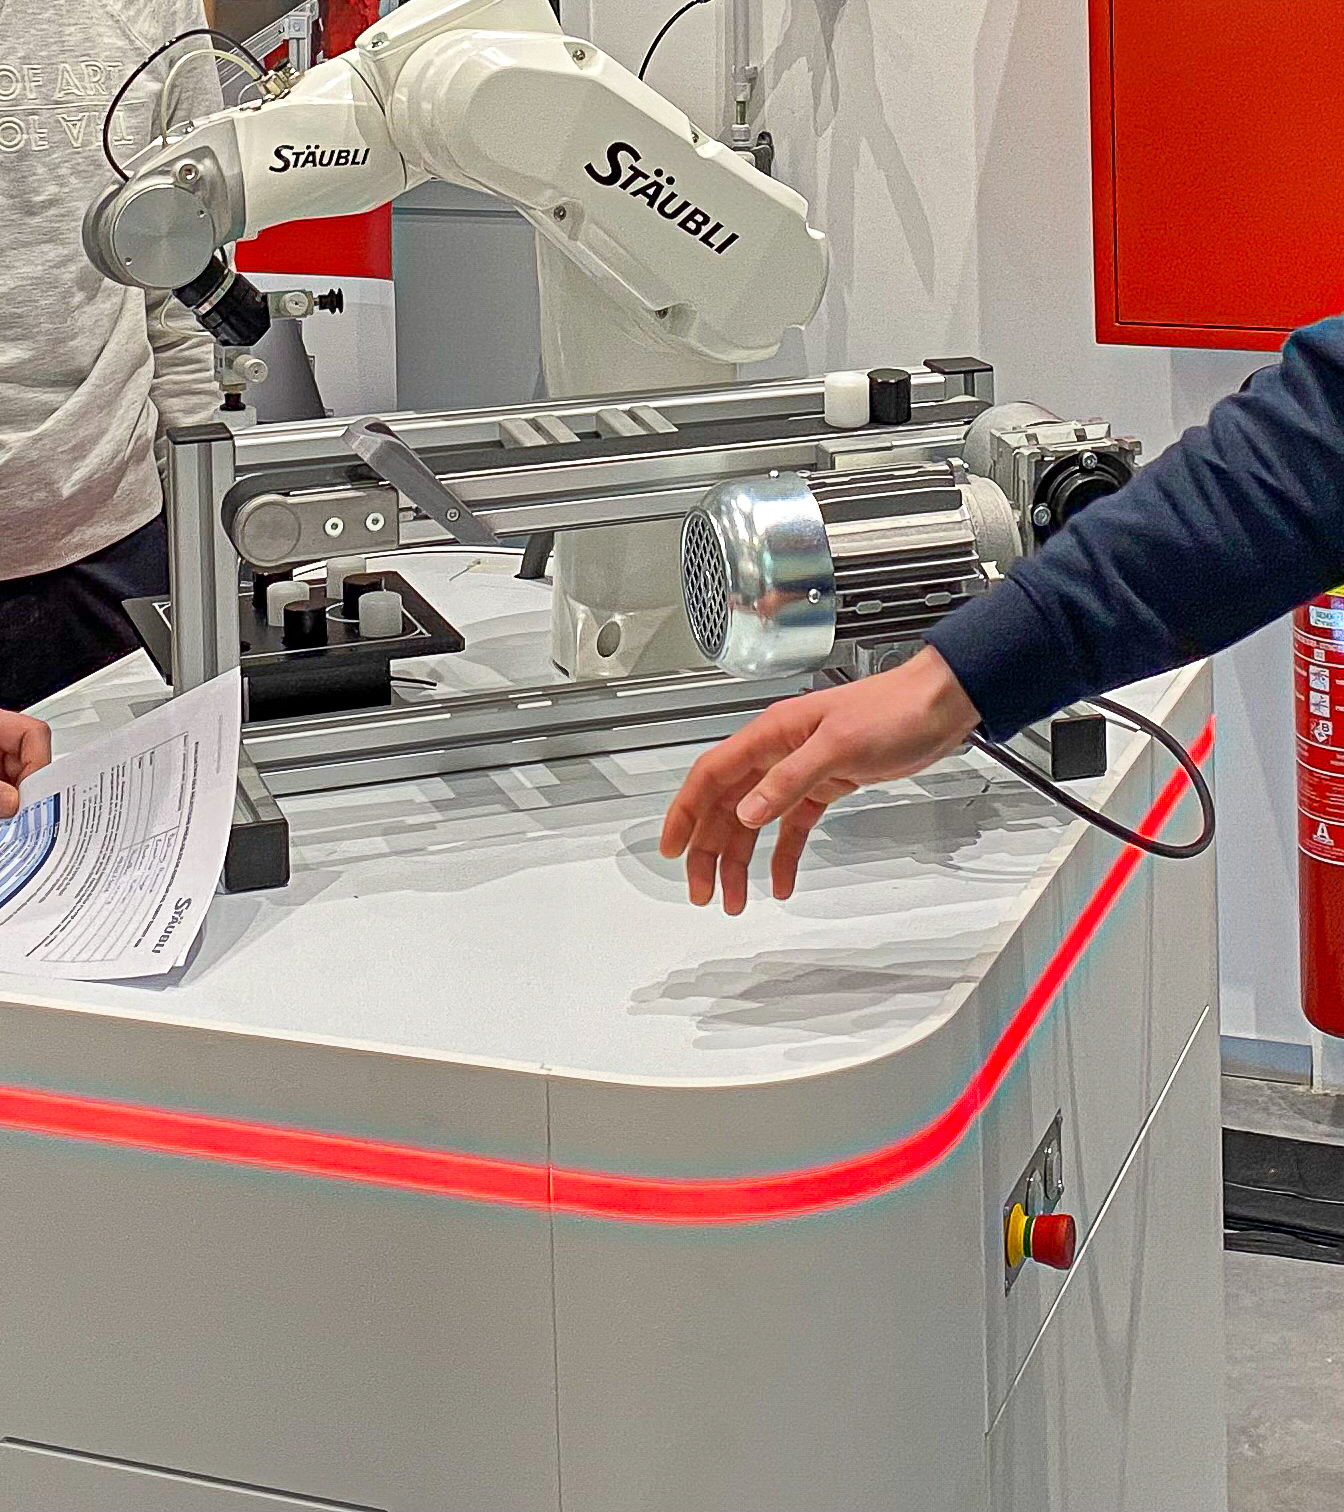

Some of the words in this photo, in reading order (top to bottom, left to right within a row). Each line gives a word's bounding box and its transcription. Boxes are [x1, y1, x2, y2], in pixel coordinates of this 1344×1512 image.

[51, 60, 124, 101] ART
[268, 143, 371, 173] STÄUBLI
[584, 141, 740, 255] STÄUBLI
